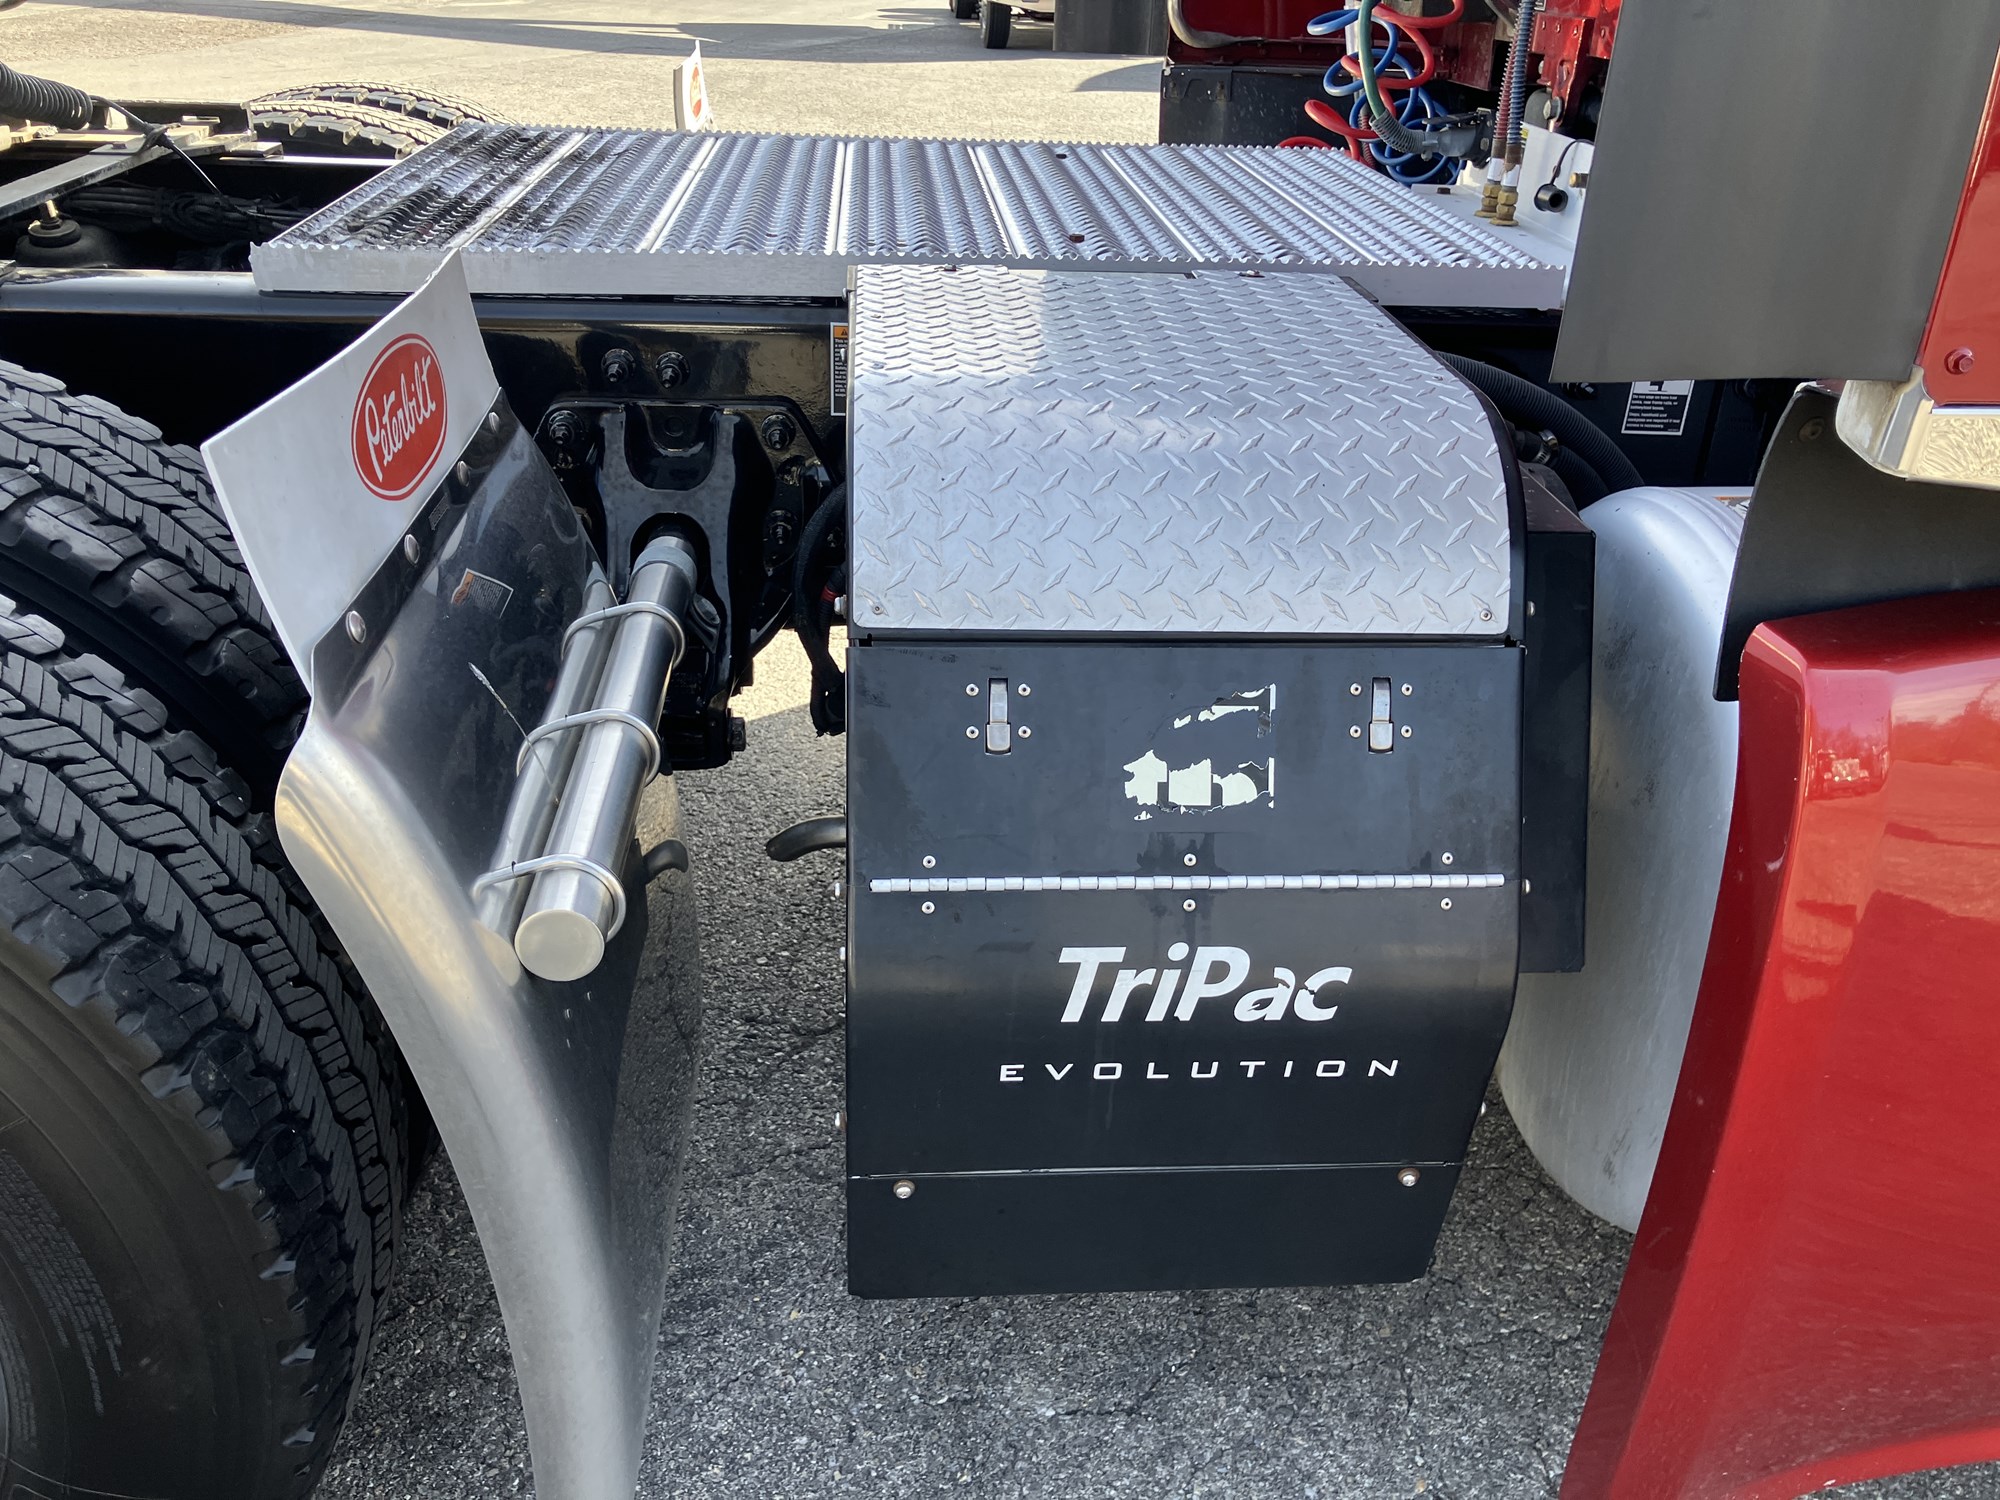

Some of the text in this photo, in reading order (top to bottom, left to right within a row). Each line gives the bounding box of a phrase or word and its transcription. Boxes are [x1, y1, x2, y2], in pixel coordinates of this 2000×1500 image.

[365, 355, 436, 483] Peterbilt
[1058, 941, 1353, 1023] TriPac
[999, 1059, 1400, 1082] EVOLUTION
